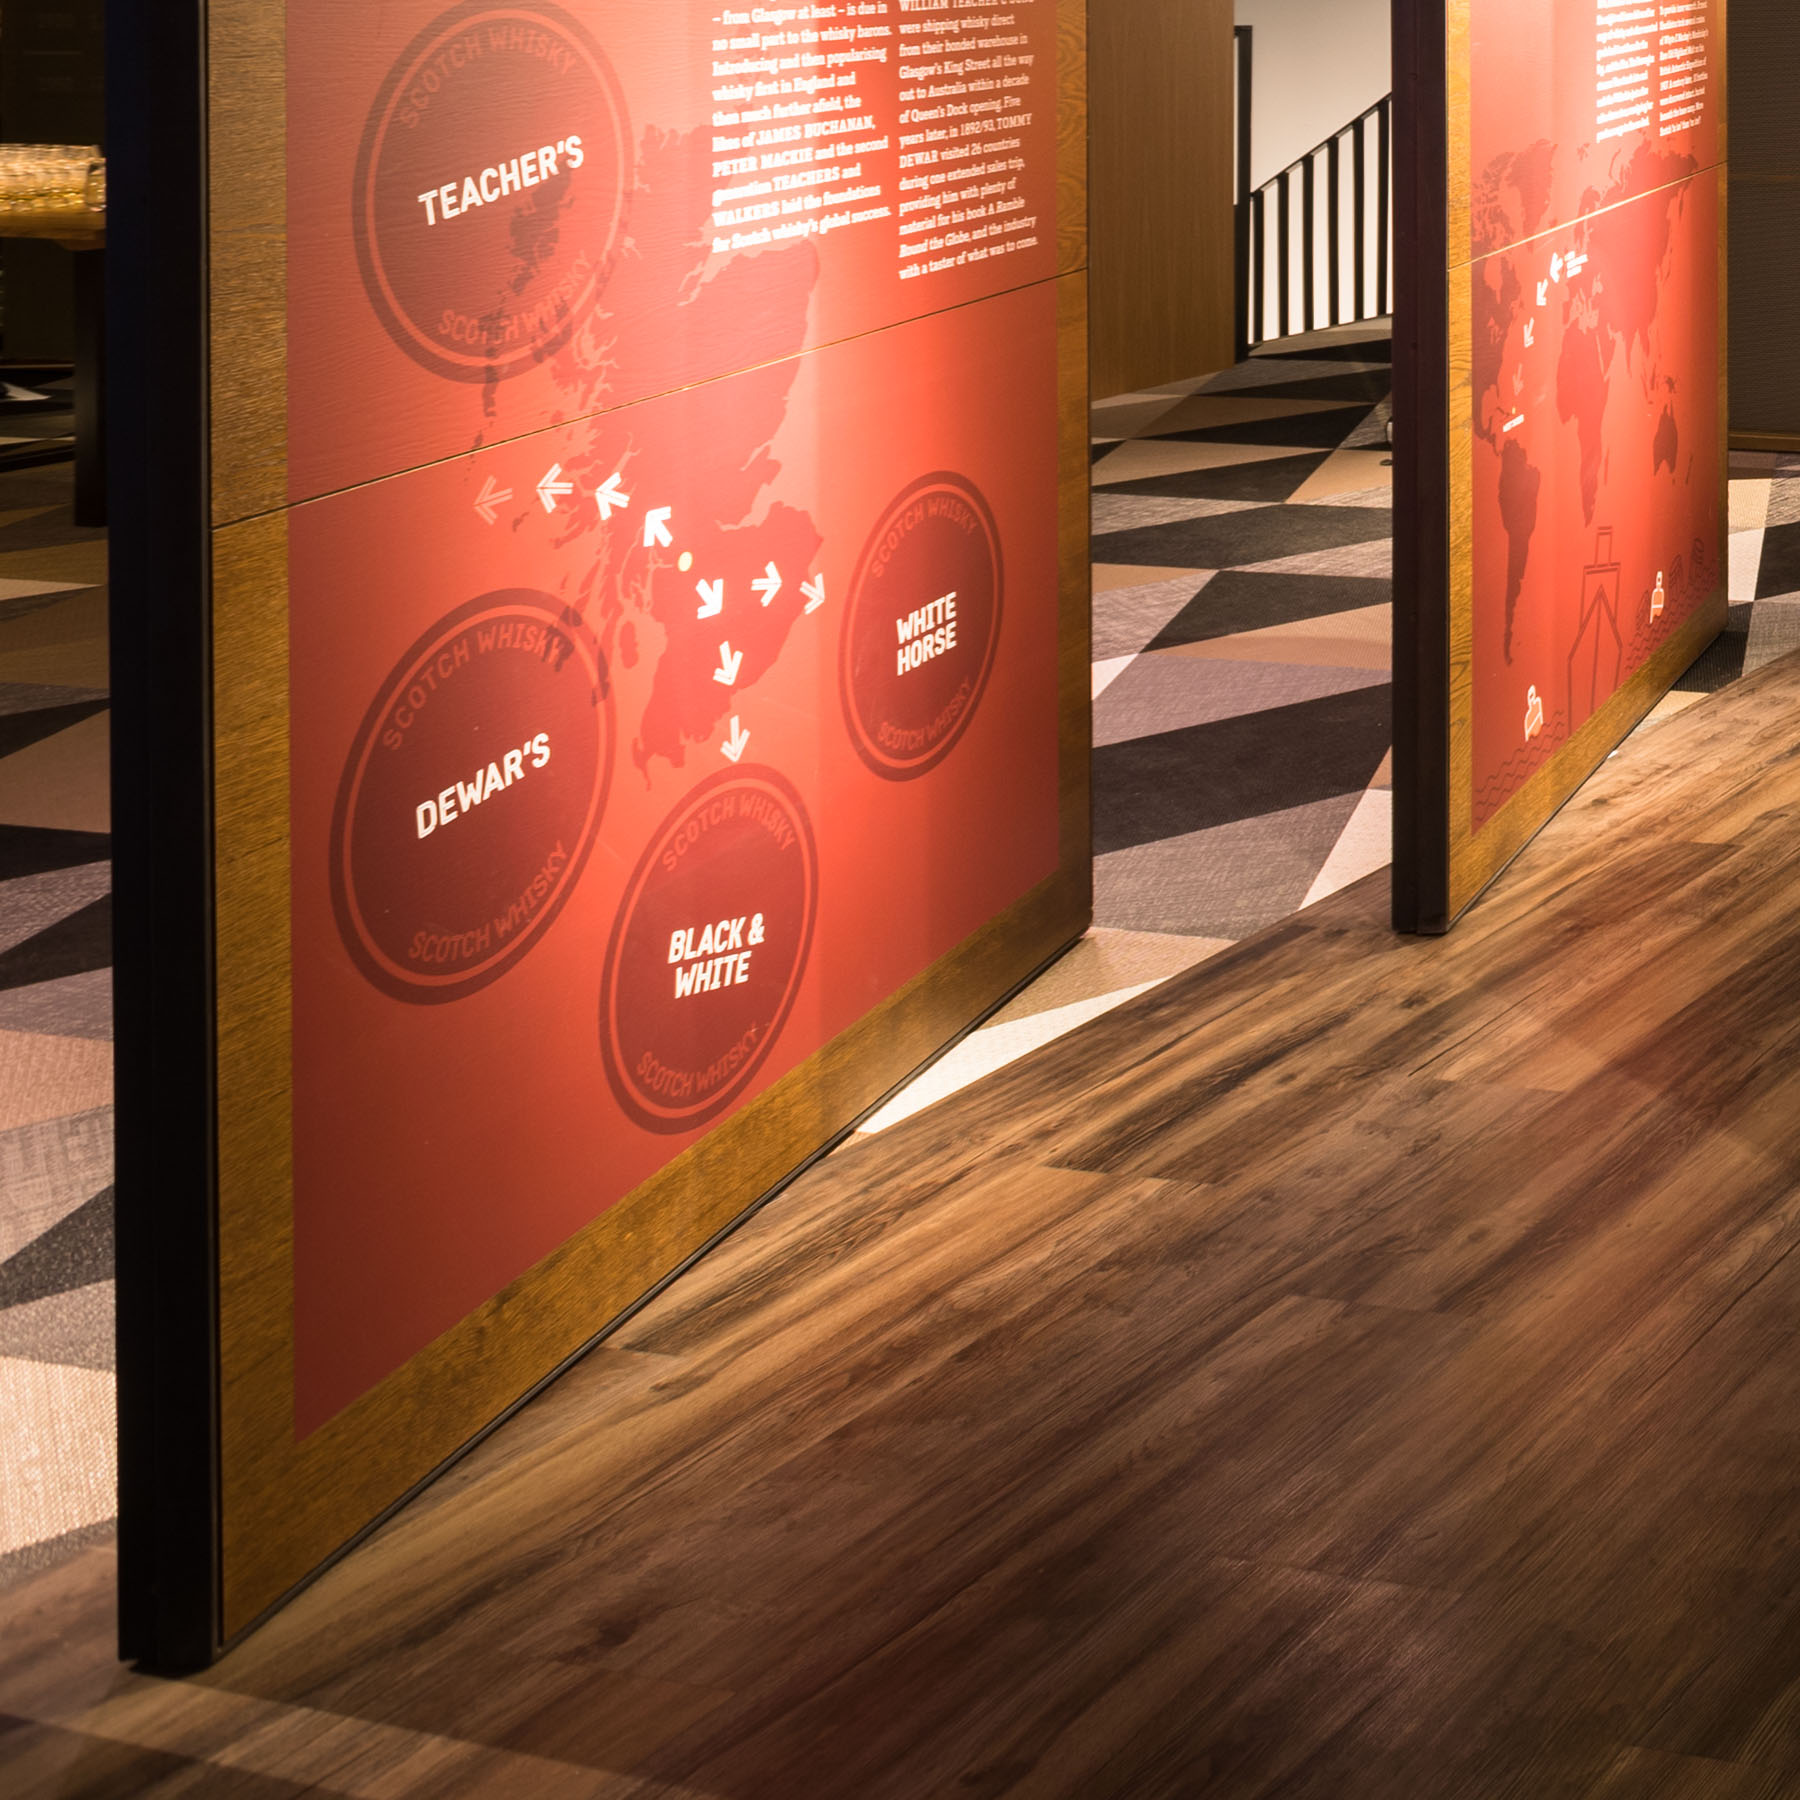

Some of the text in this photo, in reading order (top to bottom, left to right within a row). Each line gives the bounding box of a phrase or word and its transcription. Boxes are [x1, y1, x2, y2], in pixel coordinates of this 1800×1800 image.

[899, 14, 1015, 35] were shipping whisky direct
[899, 33, 1028, 56] from their bonded warehouse in
[400, 25, 577, 129] SCOTCH WHISKY
[899, 54, 1035, 80] Glasgow's King Street all the way
[899, 88, 915, 101] out
[916, 87, 927, 98] to
[928, 81, 967, 97] Australia
[968, 77, 995, 92] within
[1002, 73, 1030, 87] decade
[899, 109, 910, 124] of
[911, 106, 945, 122] Queen's
[946, 102, 968, 117] Dock
[1004, 96, 1021, 107] Five
[899, 133, 925, 149] years
[949, 125, 959, 138] in
[997, 112, 1033, 129] TOMMY
[899, 137, 1020, 169] DEWAR visited 26 countries
[418, 135, 584, 226] TEACHER'S
[870, 499, 976, 578] SCOTCH WHISKY
[896, 591, 957, 644] WHITE
[897, 619, 957, 675] HORSE
[383, 623, 566, 750] SCOTCH WHISKY
[877, 676, 974, 752] SCOTCH WHISKY
[416, 732, 550, 840] DEWAR'S
[661, 793, 795, 872] SCOTCH WHISKY
[409, 840, 569, 963] SCOTCH WHISKY
[667, 913, 765, 964] BLACK &
[674, 950, 752, 999] WHITE
[636, 1021, 759, 1096] SCOTCH WHISKY
